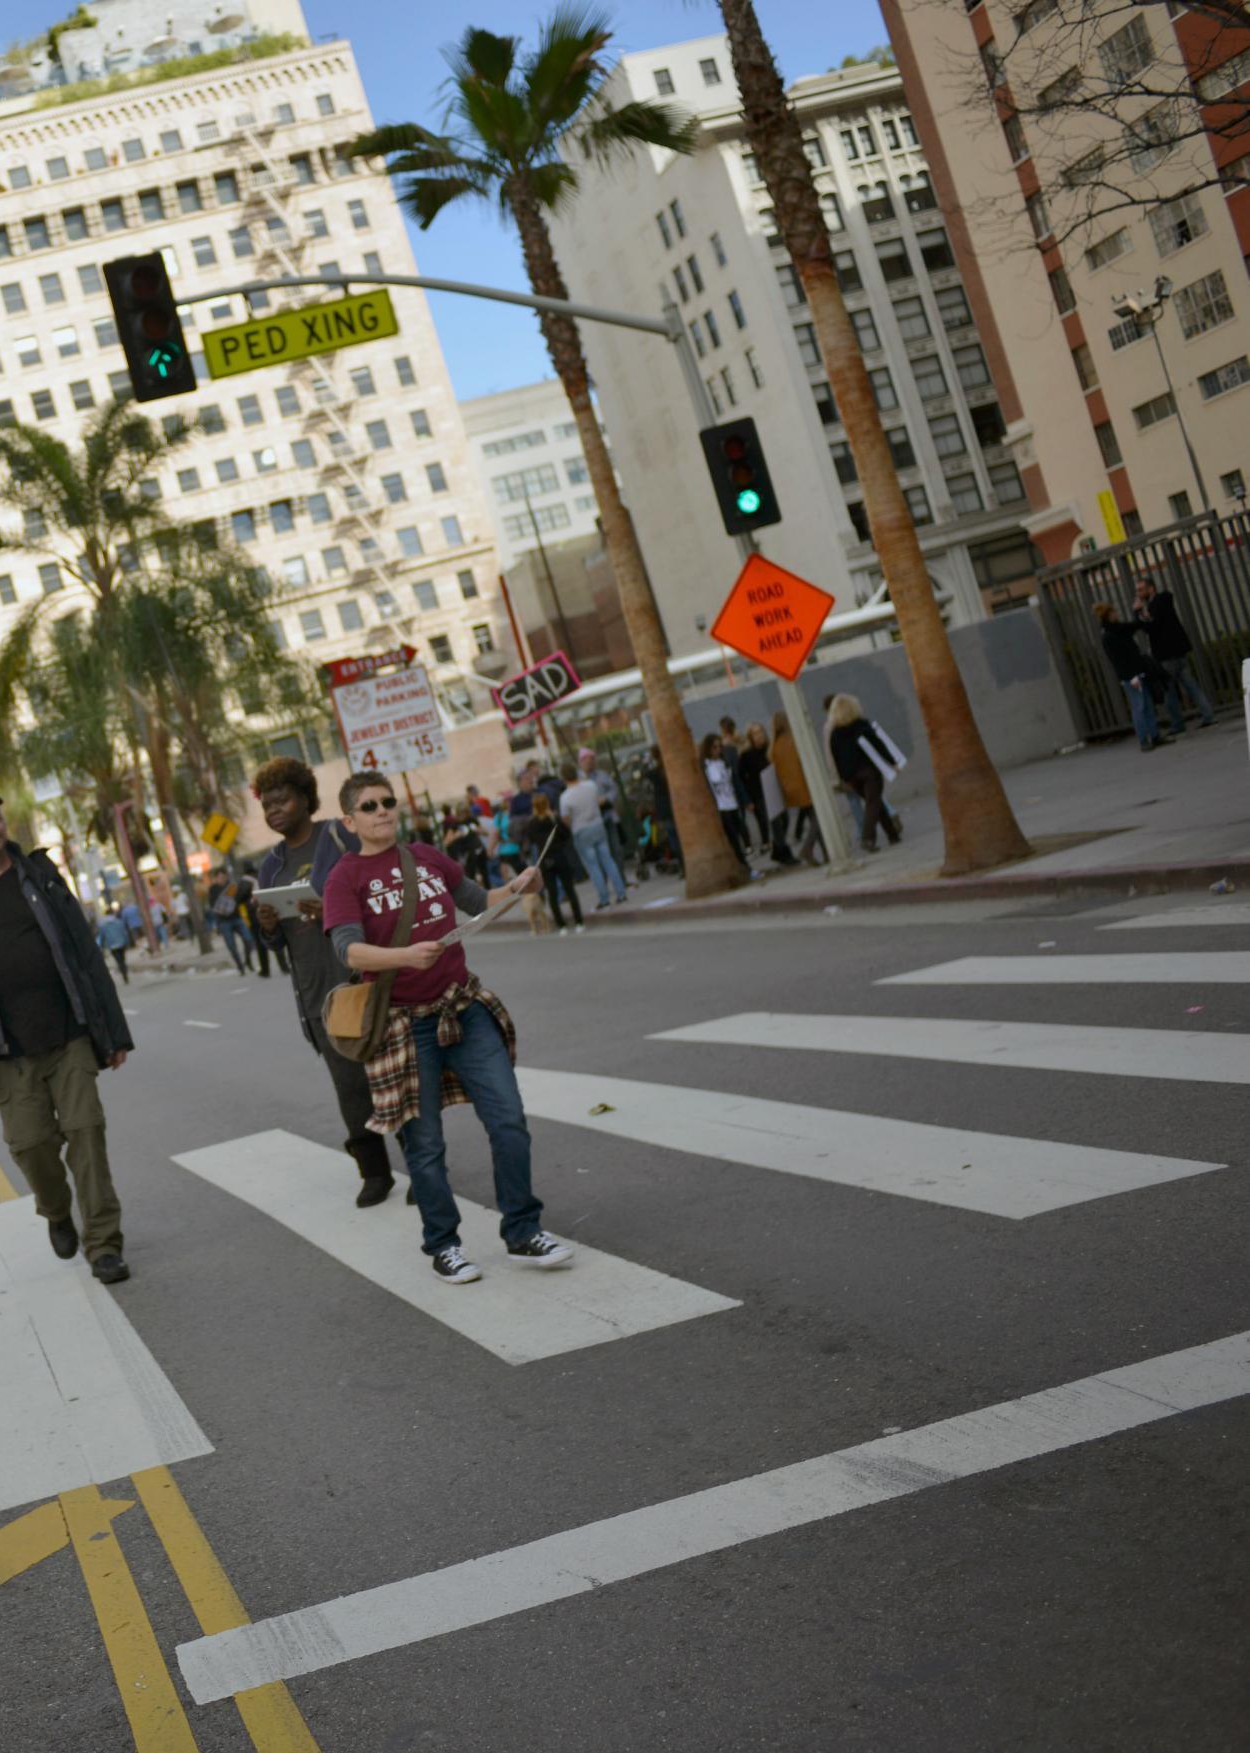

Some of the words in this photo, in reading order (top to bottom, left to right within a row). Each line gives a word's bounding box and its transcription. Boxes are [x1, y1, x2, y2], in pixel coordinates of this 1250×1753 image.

[221, 325, 287, 367] PED
[302, 302, 381, 346] XING
[747, 582, 784, 607] ROAD
[753, 606, 793, 629] WORK
[758, 628, 803, 653] AHEAD
[341, 650, 407, 676] ENTRANCE
[376, 672, 418, 691] PUBLIC
[500, 662, 570, 721] SAD
[376, 687, 428, 707] PARKING
[350, 721, 390, 744] JEWELRY
[393, 711, 433, 732] DISTRICT
[367, 877, 447, 915] VEAN
